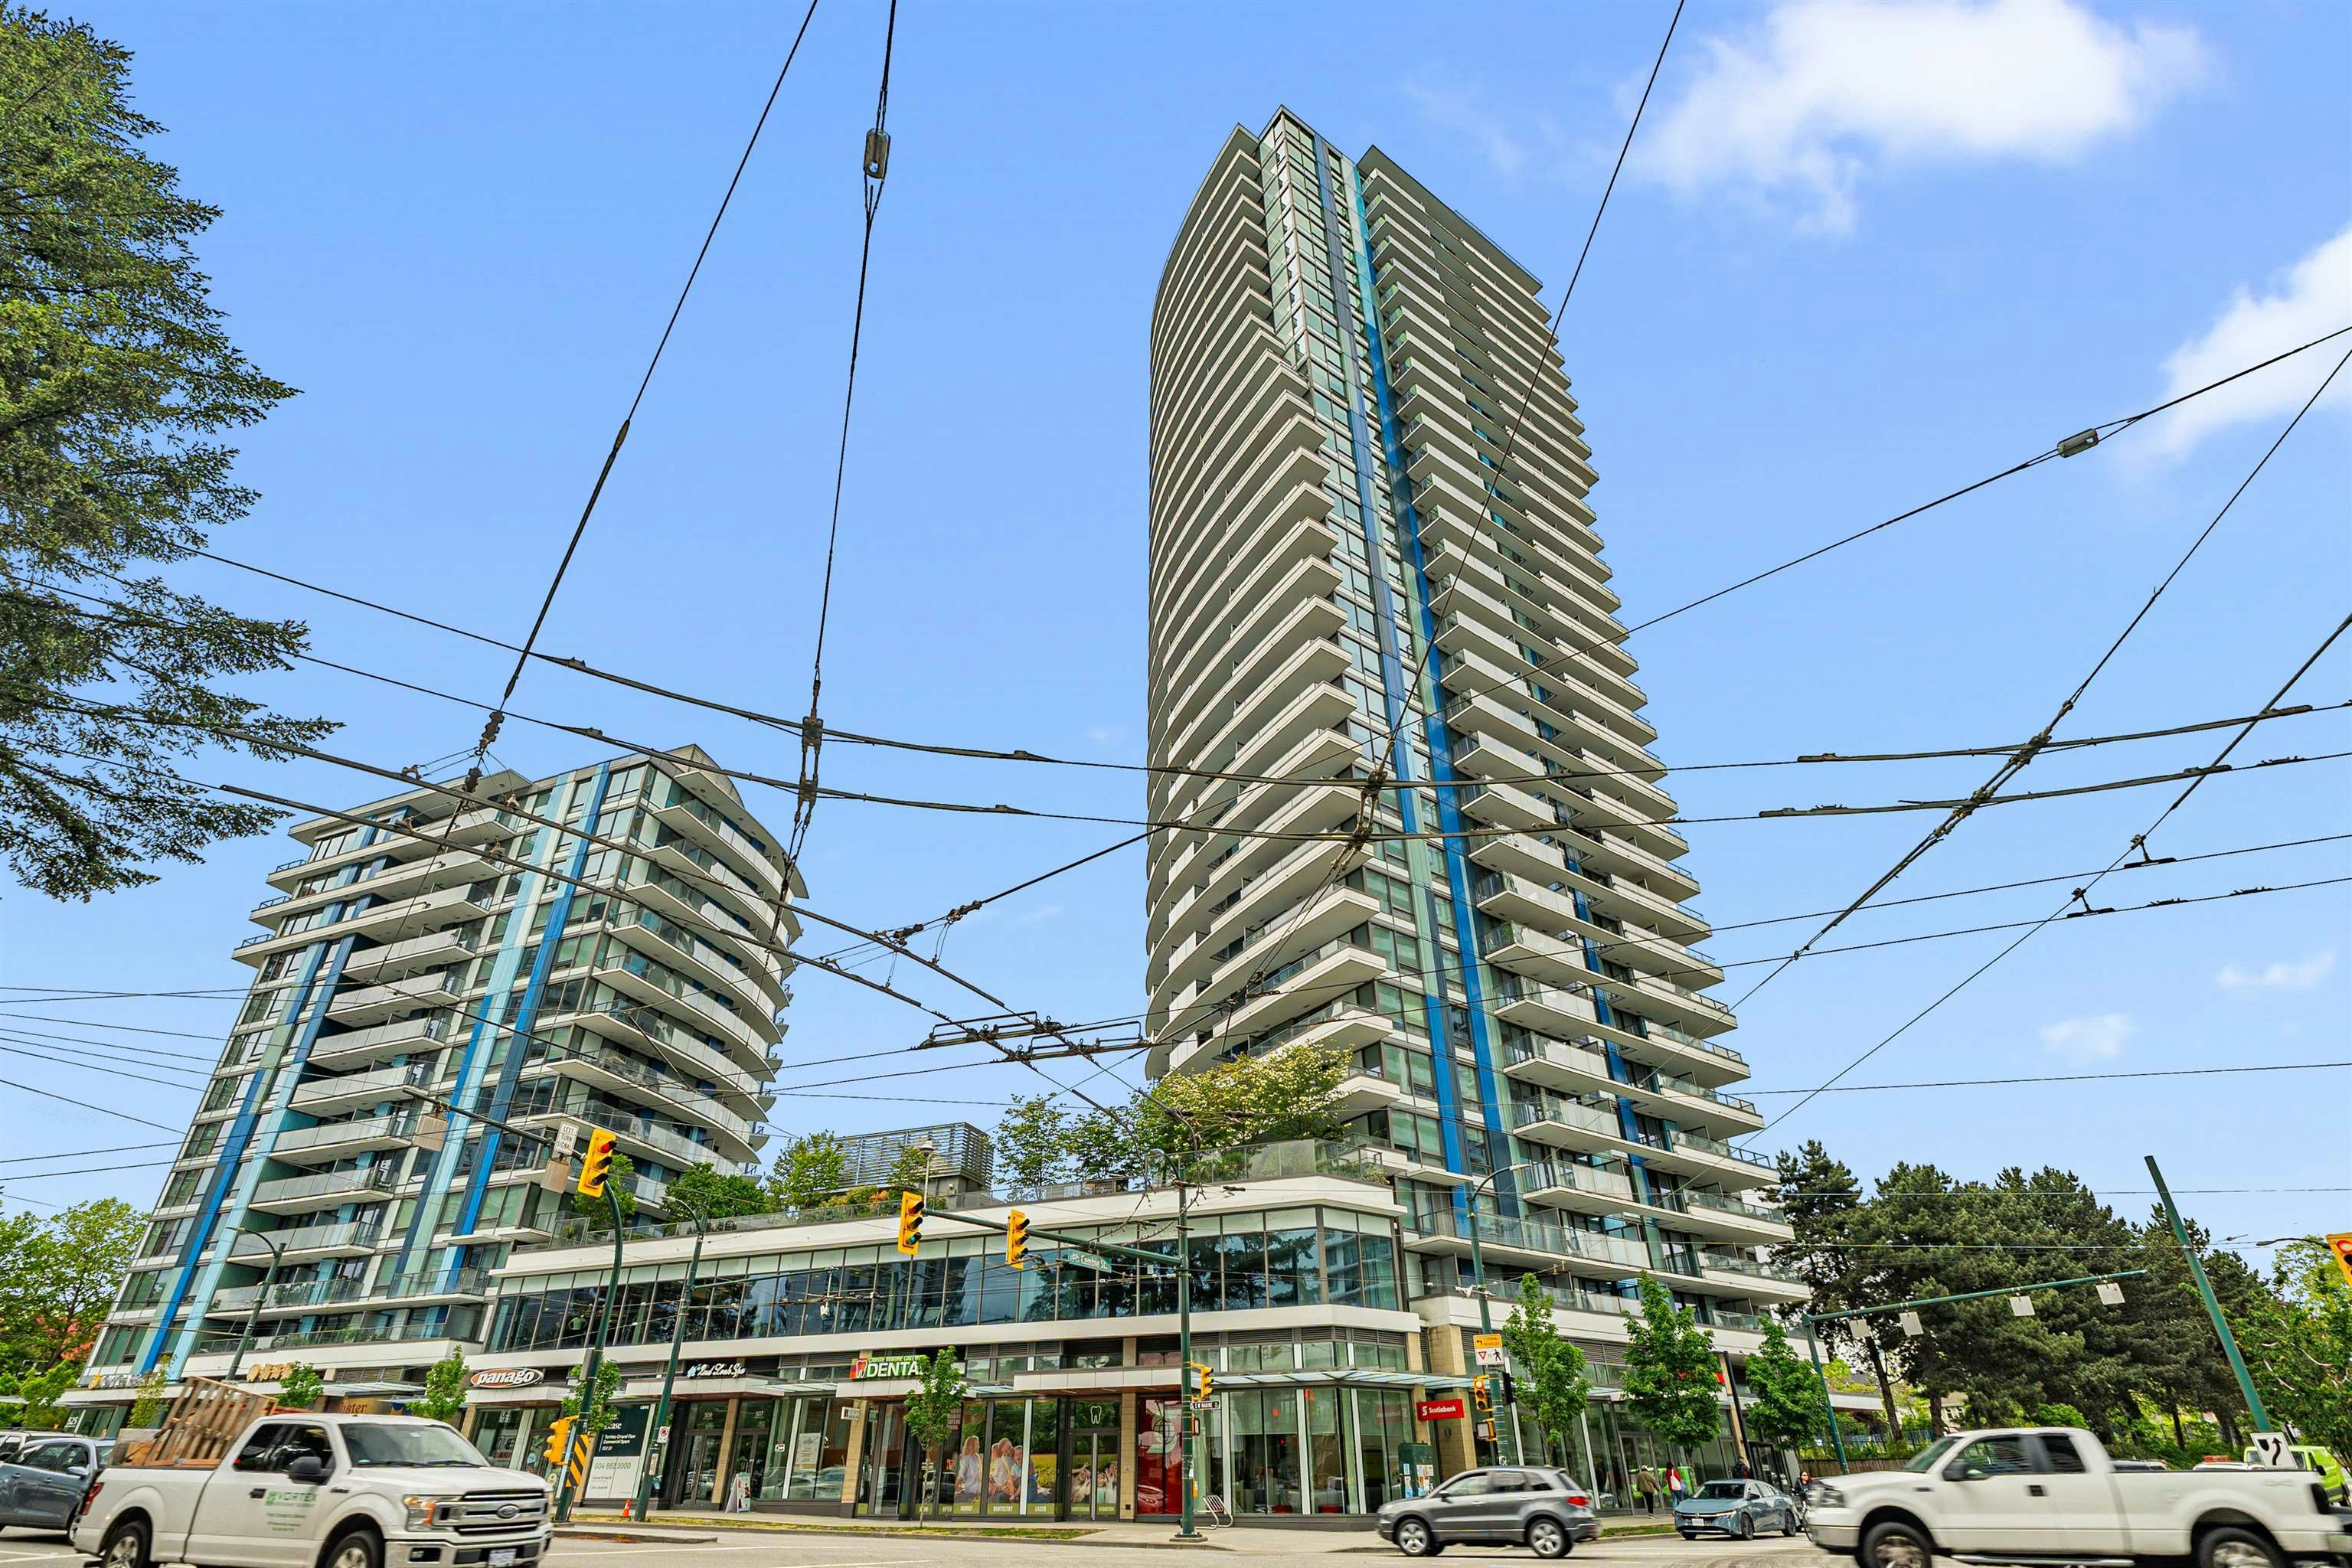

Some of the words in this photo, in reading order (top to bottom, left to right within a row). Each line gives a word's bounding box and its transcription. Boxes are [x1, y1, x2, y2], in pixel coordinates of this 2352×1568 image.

[557, 1141, 572, 1149] SIGNAL
[1080, 1255, 1099, 1268] Cambie
[476, 1369, 535, 1385] panago
[1429, 1405, 1456, 1414] Scotiabank
[67, 1416, 79, 1425] 525
